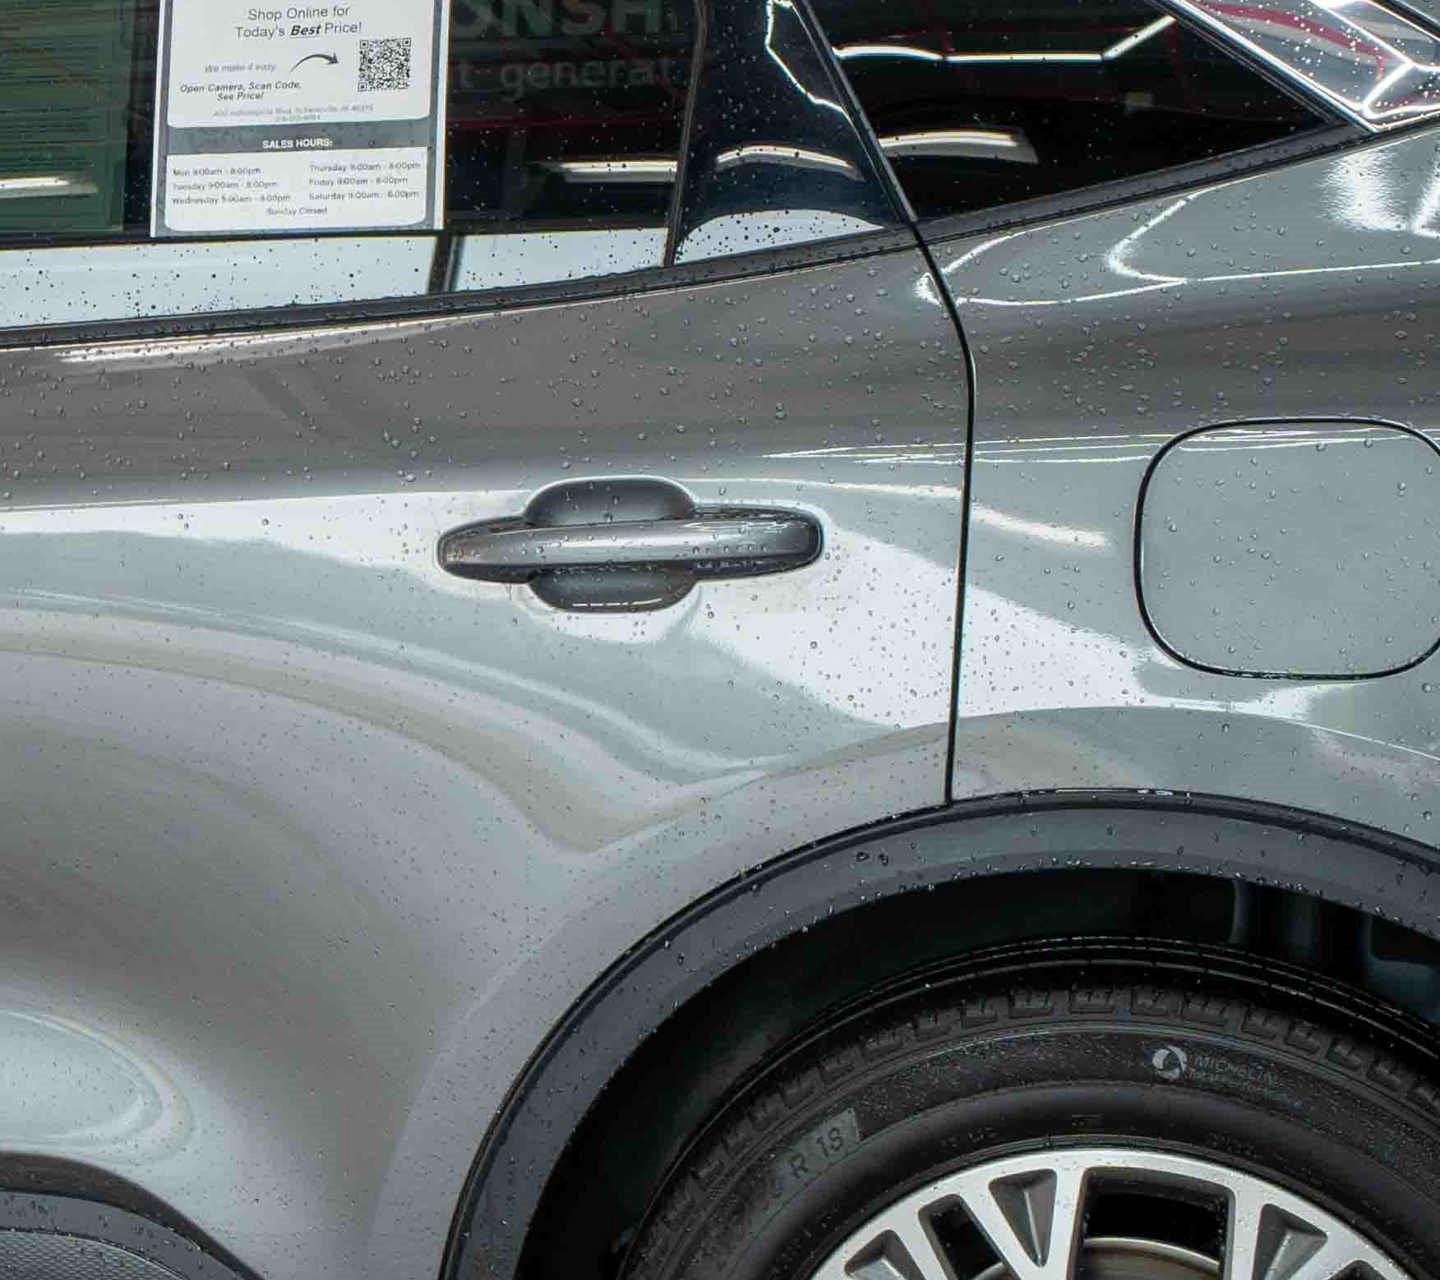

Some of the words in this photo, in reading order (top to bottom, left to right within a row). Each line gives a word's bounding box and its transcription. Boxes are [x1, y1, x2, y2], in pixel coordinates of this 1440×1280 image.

[248, 9, 282, 22] Shop
[286, 7, 328, 20] Online
[333, 5, 350, 17] for
[236, 25, 285, 40] Today's
[290, 24, 322, 37] Best
[324, 22, 363, 35] Price!
[180, 84, 205, 94] Open
[207, 83, 246, 93] Camera,
[248, 81, 272, 90] Scan
[217, 92, 234, 101] See
[237, 91, 265, 100] Price!
[262, 139, 294, 150] SALES
